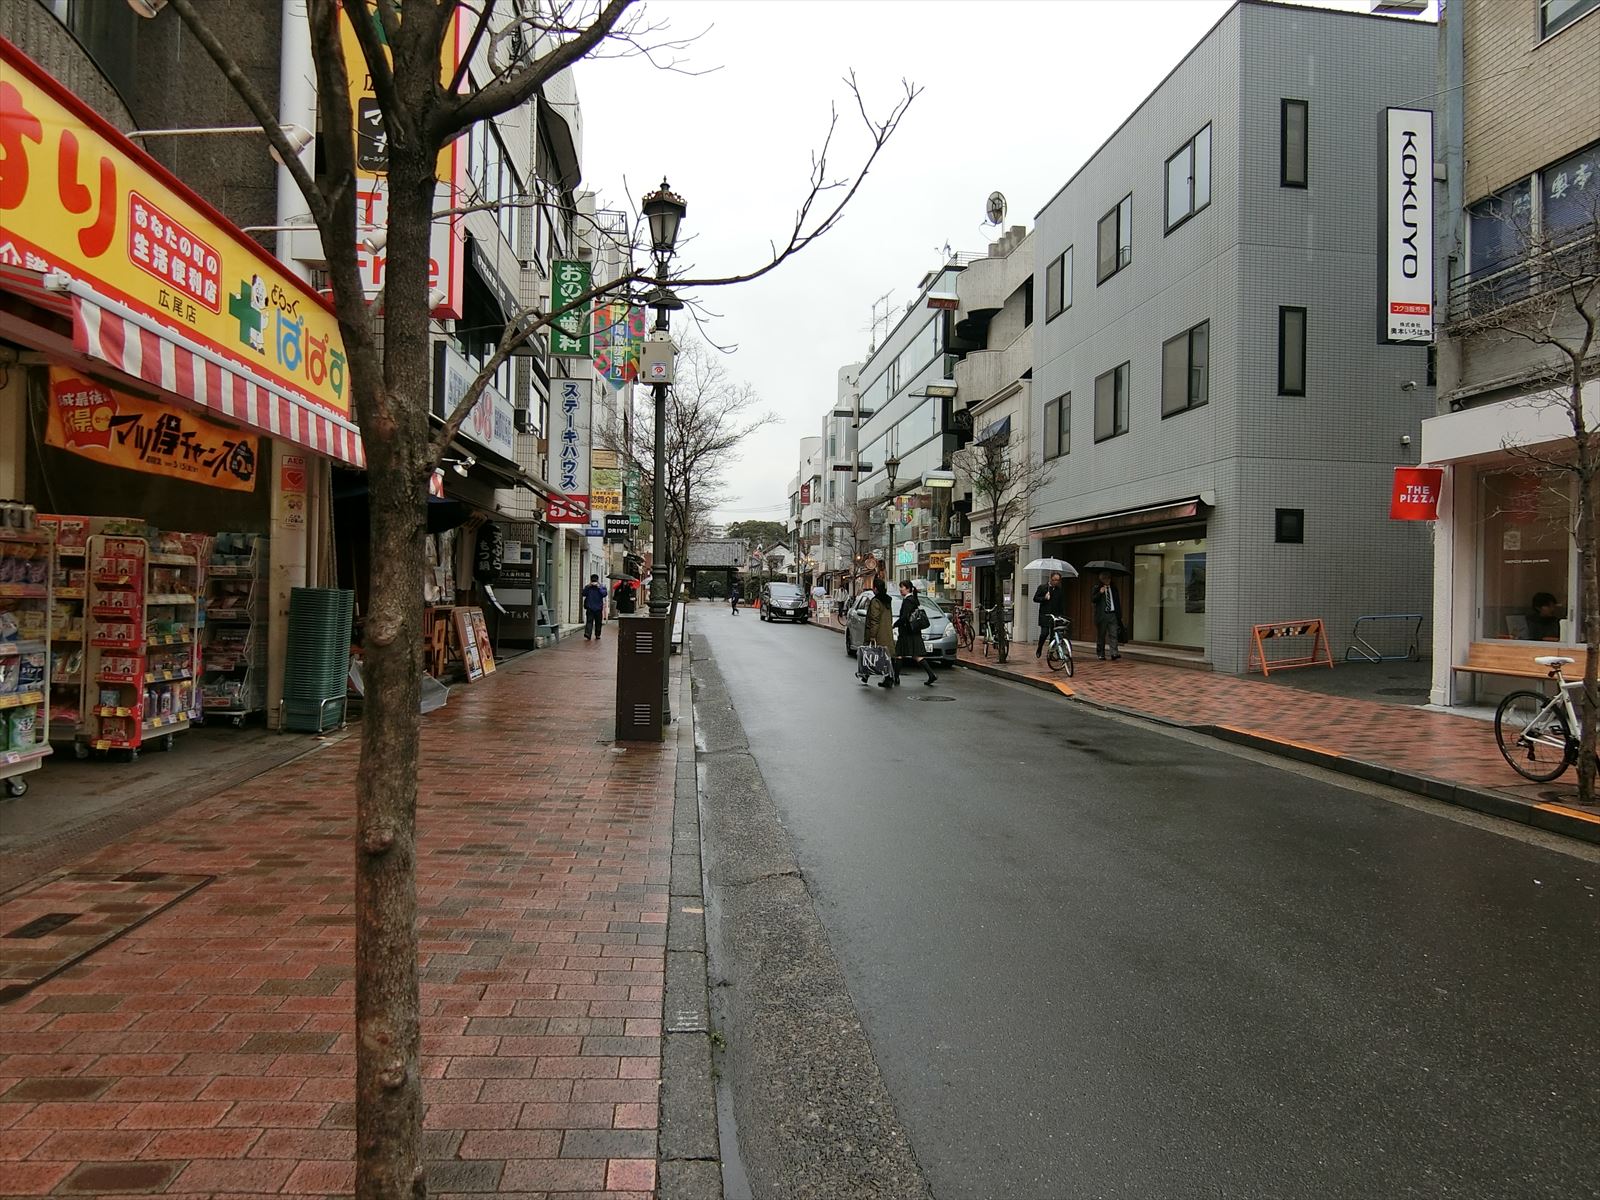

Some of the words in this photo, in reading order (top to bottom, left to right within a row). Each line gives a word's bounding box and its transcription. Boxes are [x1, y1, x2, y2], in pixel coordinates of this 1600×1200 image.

[135, 204, 217, 275] あなたの町の
[1402, 131, 1418, 279] KOKUYO
[134, 232, 217, 304] 生活便利店
[159, 288, 197, 324] 広尾店
[558, 264, 582, 352] おの歯科
[277, 308, 346, 399] ぱぱす
[288, 457, 304, 465] AED
[560, 383, 580, 490] ステーキハウス
[1400, 494, 1435, 503] PIZZA
[1406, 485, 1430, 494] THE
